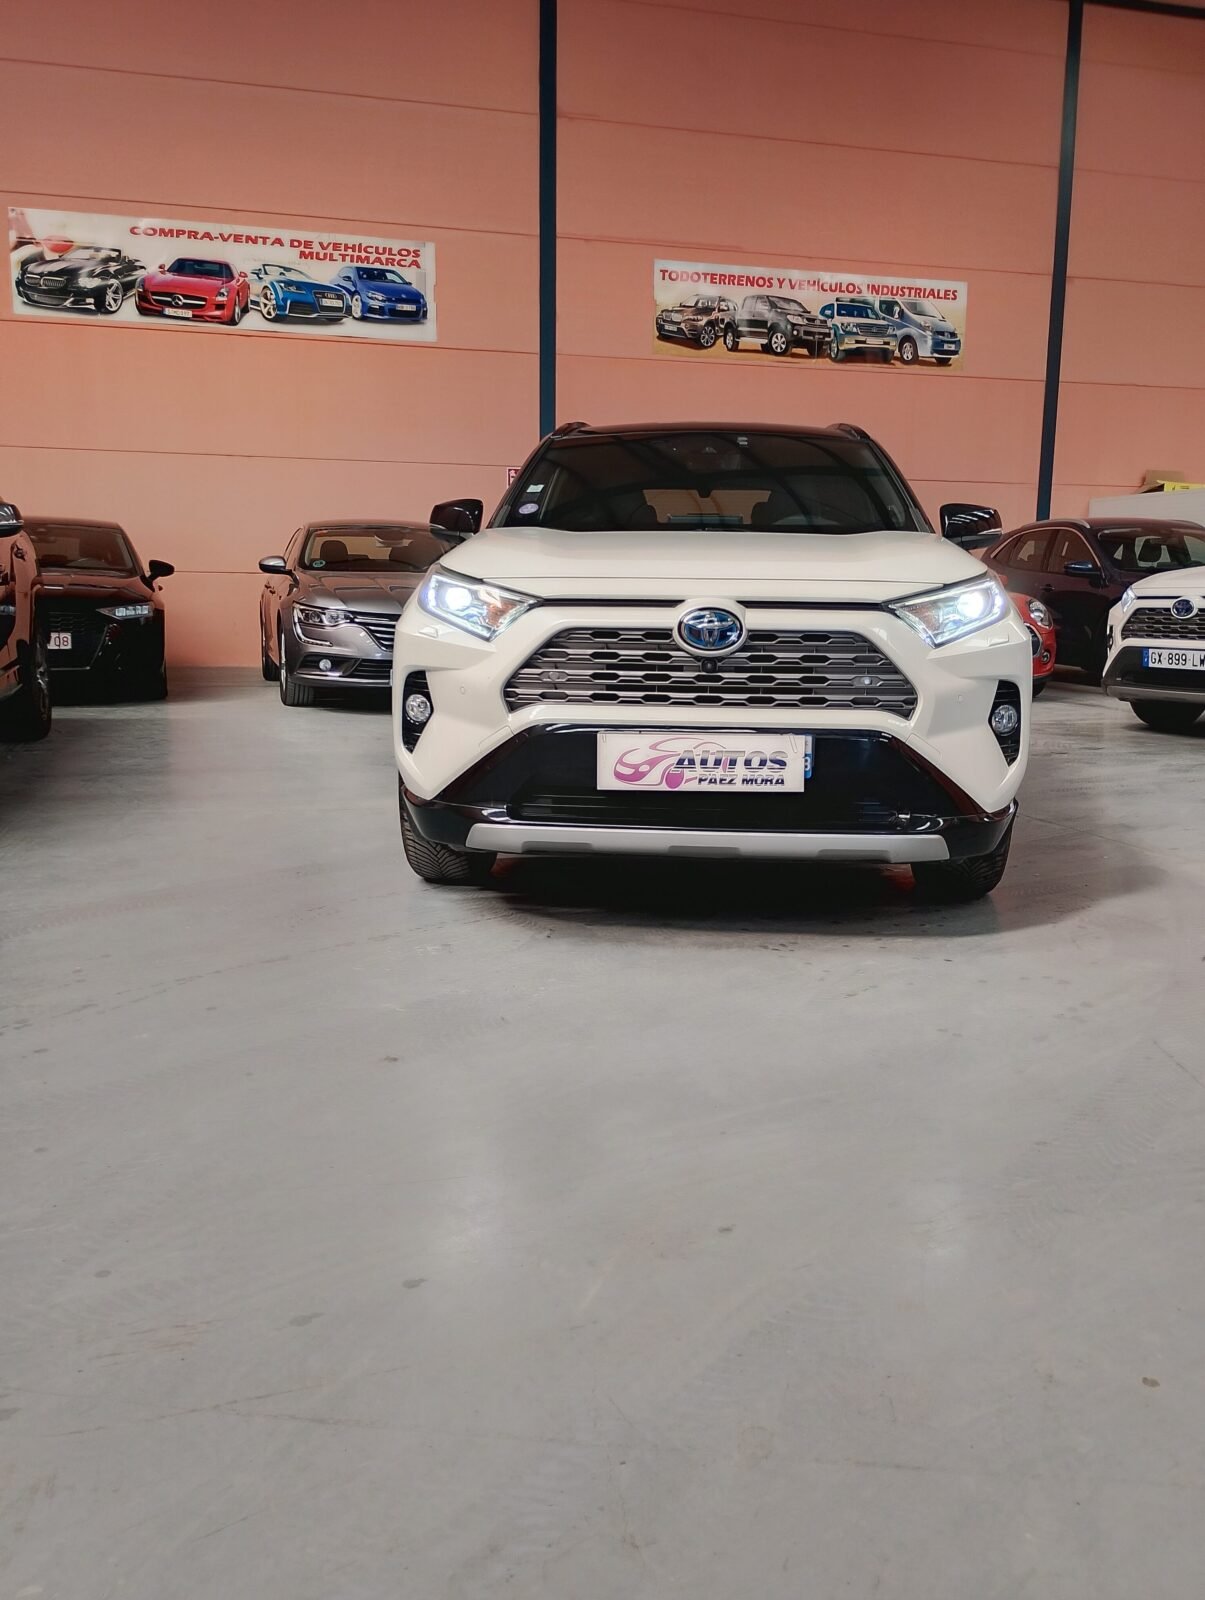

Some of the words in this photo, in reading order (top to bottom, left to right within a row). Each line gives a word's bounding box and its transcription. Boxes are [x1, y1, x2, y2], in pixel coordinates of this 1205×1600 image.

[129, 226, 284, 247] COMPRA-VENTA
[289, 239, 314, 250] DE
[318, 241, 421, 259] VEHÍCULOS
[298, 250, 421, 269] MULTIMARCA
[659, 269, 774, 289] TODOTERRENOS
[776, 279, 788, 290] Y
[788, 278, 863, 295] VEHÍCULOS
[866, 284, 959, 301] INDUSTRIALES
[671, 749, 788, 774] AUTOS
[741, 774, 785, 787] MORA
